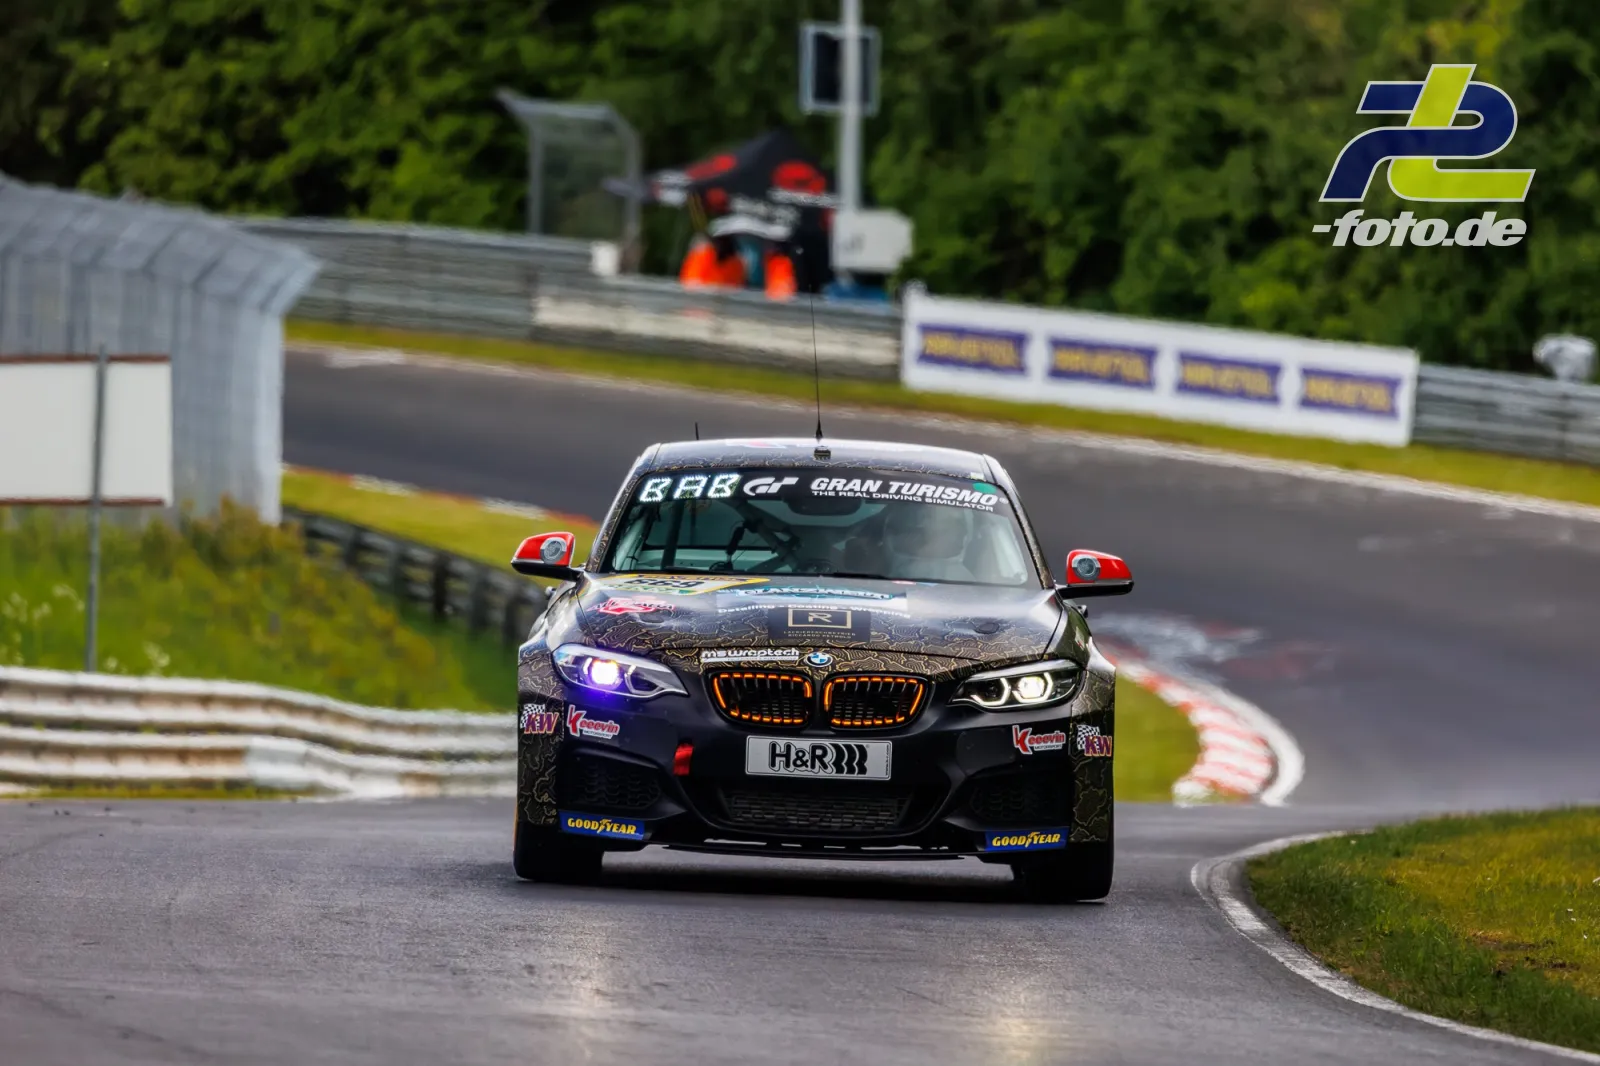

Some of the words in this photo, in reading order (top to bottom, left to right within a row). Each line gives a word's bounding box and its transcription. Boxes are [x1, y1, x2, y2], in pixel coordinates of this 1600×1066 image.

[810, 477, 884, 493] GRAN
[889, 481, 999, 506] TURISMO
[872, 493, 922, 502] DRIVING
[925, 497, 994, 512] SIMULATOR
[717, 603, 776, 614] Detailing
[807, 612, 833, 623] R
[567, 818, 637, 835] GOODYEAR
[992, 832, 1061, 848] GOODYEAR
